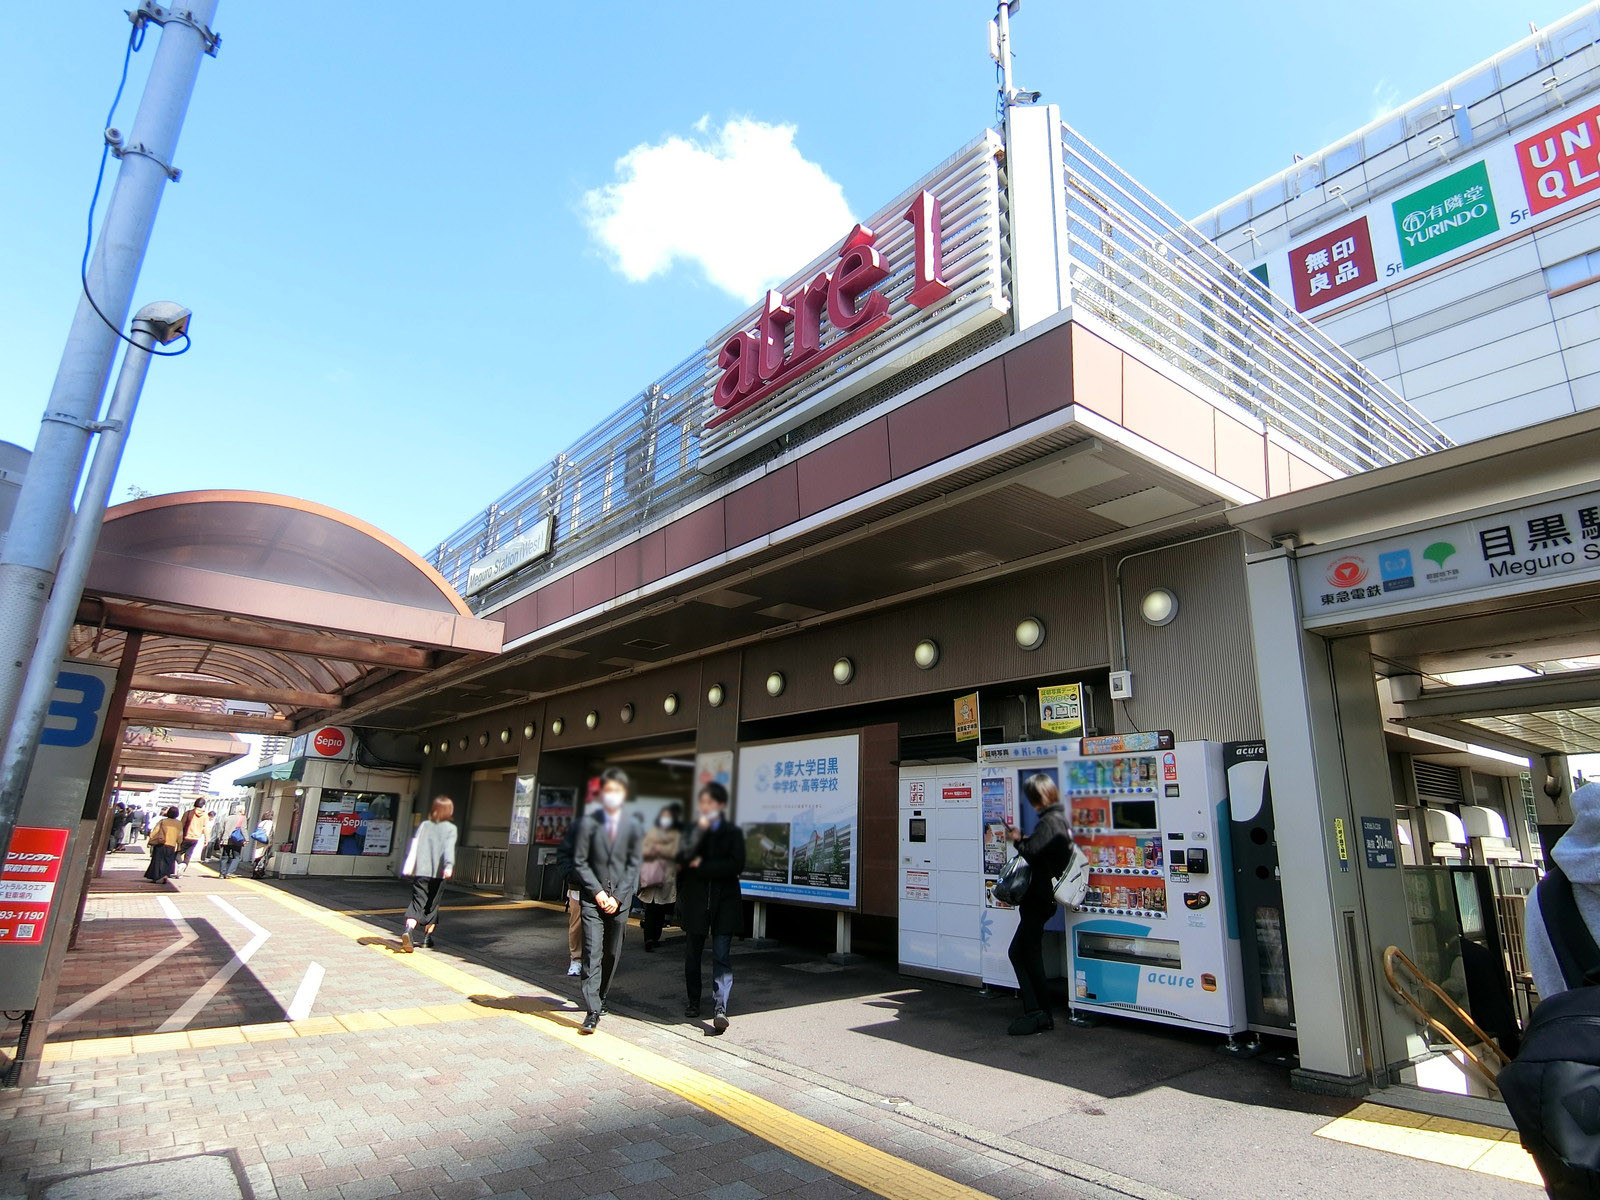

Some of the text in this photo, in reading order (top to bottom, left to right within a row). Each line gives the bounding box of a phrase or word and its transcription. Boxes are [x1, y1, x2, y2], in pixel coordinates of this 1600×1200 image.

[1537, 151, 1600, 199] QL
[1425, 185, 1485, 221] 有隣堂
[1404, 203, 1488, 247] YURINDO
[1510, 208, 1529, 225] 5F
[1305, 236, 1355, 274] 無印
[1309, 260, 1360, 297] 良品
[1386, 262, 1402, 277] 5F
[713, 189, 953, 409] atré 1
[468, 566, 493, 589] Meguro
[494, 549, 519, 574] Station
[1489, 551, 1575, 578] Meguro
[1320, 584, 1382, 606] 東急電鉄
[316, 735, 343, 748] Sepia
[1021, 744, 1058, 757] Ki-Re-i
[1236, 746, 1265, 755] acure
[774, 757, 839, 778] 多摩大学目黒
[773, 777, 838, 793] 中学校・高等学校
[342, 816, 368, 829] Sepia
[0, 910, 45, 920] 93-1190
[1147, 971, 1195, 989] acure
